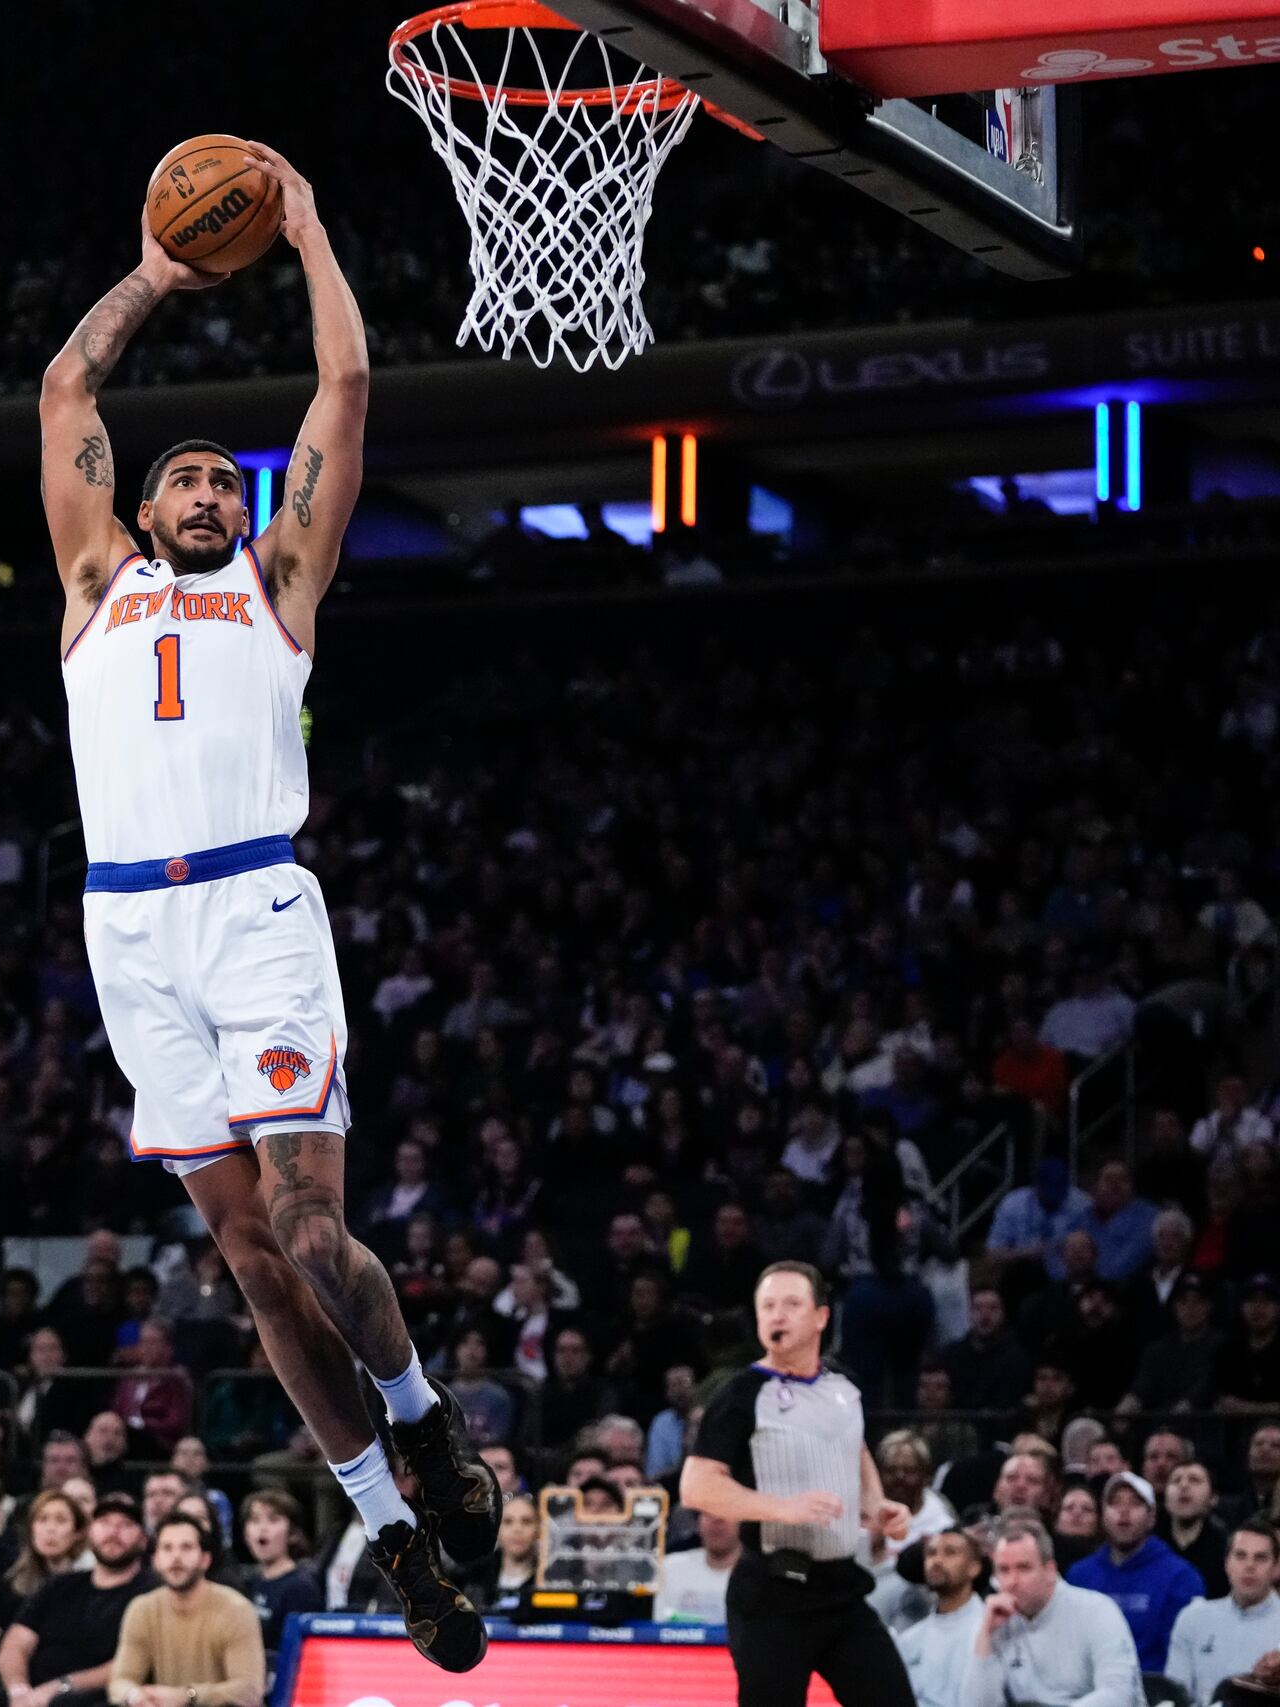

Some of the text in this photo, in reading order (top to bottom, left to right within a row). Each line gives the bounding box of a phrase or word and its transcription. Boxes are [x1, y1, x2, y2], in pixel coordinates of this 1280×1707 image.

[170, 187, 254, 248] Wilson
[817, 342, 1051, 392] LEXUS
[1124, 321, 1246, 368] SUITE
[292, 444, 324, 528] Daniel
[104, 582, 253, 634] NEW YORK
[153, 633, 185, 721] 1
[257, 1048, 311, 1076] KNICKS
